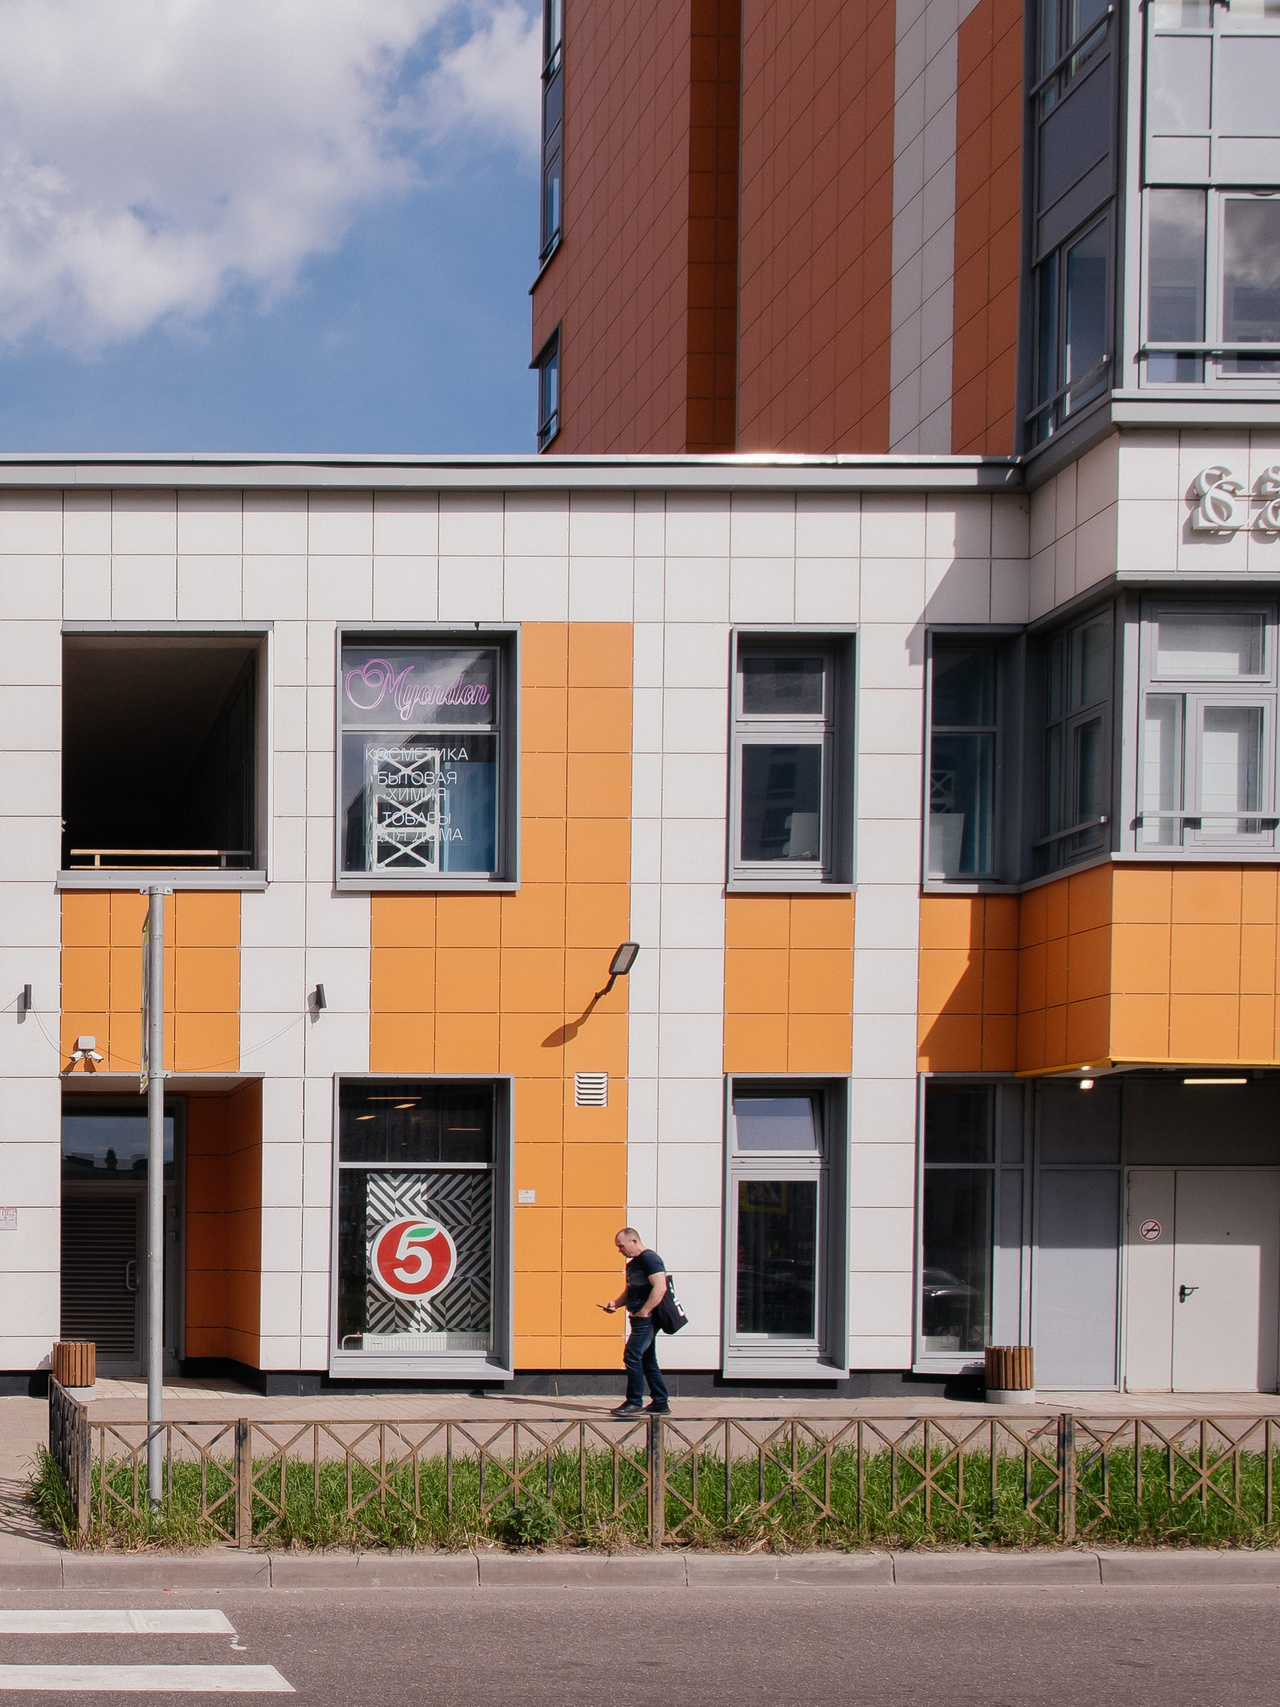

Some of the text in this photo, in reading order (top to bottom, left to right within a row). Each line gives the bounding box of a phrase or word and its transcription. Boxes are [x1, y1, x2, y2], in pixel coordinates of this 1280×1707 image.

[365, 747, 469, 762] КОСМЕТИКА
[377, 771, 457, 786] БЫТОВАЯ
[388, 787, 447, 802] ХИМИЯ
[382, 811, 452, 826] ТОВАРЫ
[393, 1223, 440, 1284] 5
